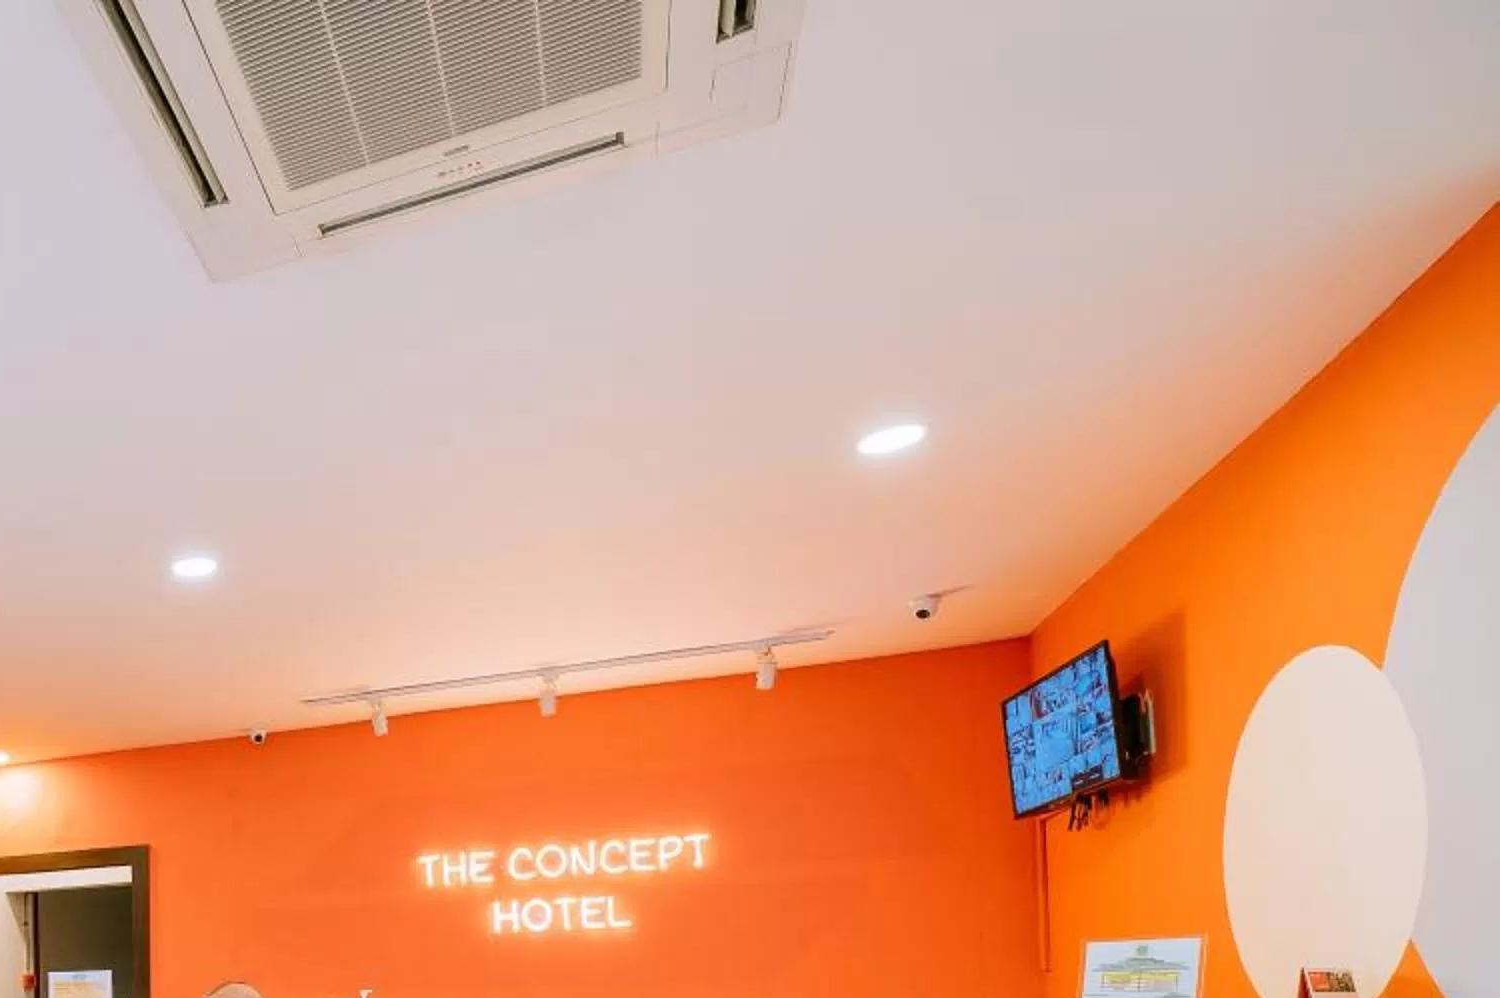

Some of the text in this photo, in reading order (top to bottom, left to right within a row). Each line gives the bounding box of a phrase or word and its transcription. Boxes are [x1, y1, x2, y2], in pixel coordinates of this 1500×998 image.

[417, 833, 711, 887] THE CONCEPT
[491, 896, 632, 933] HOTEL
